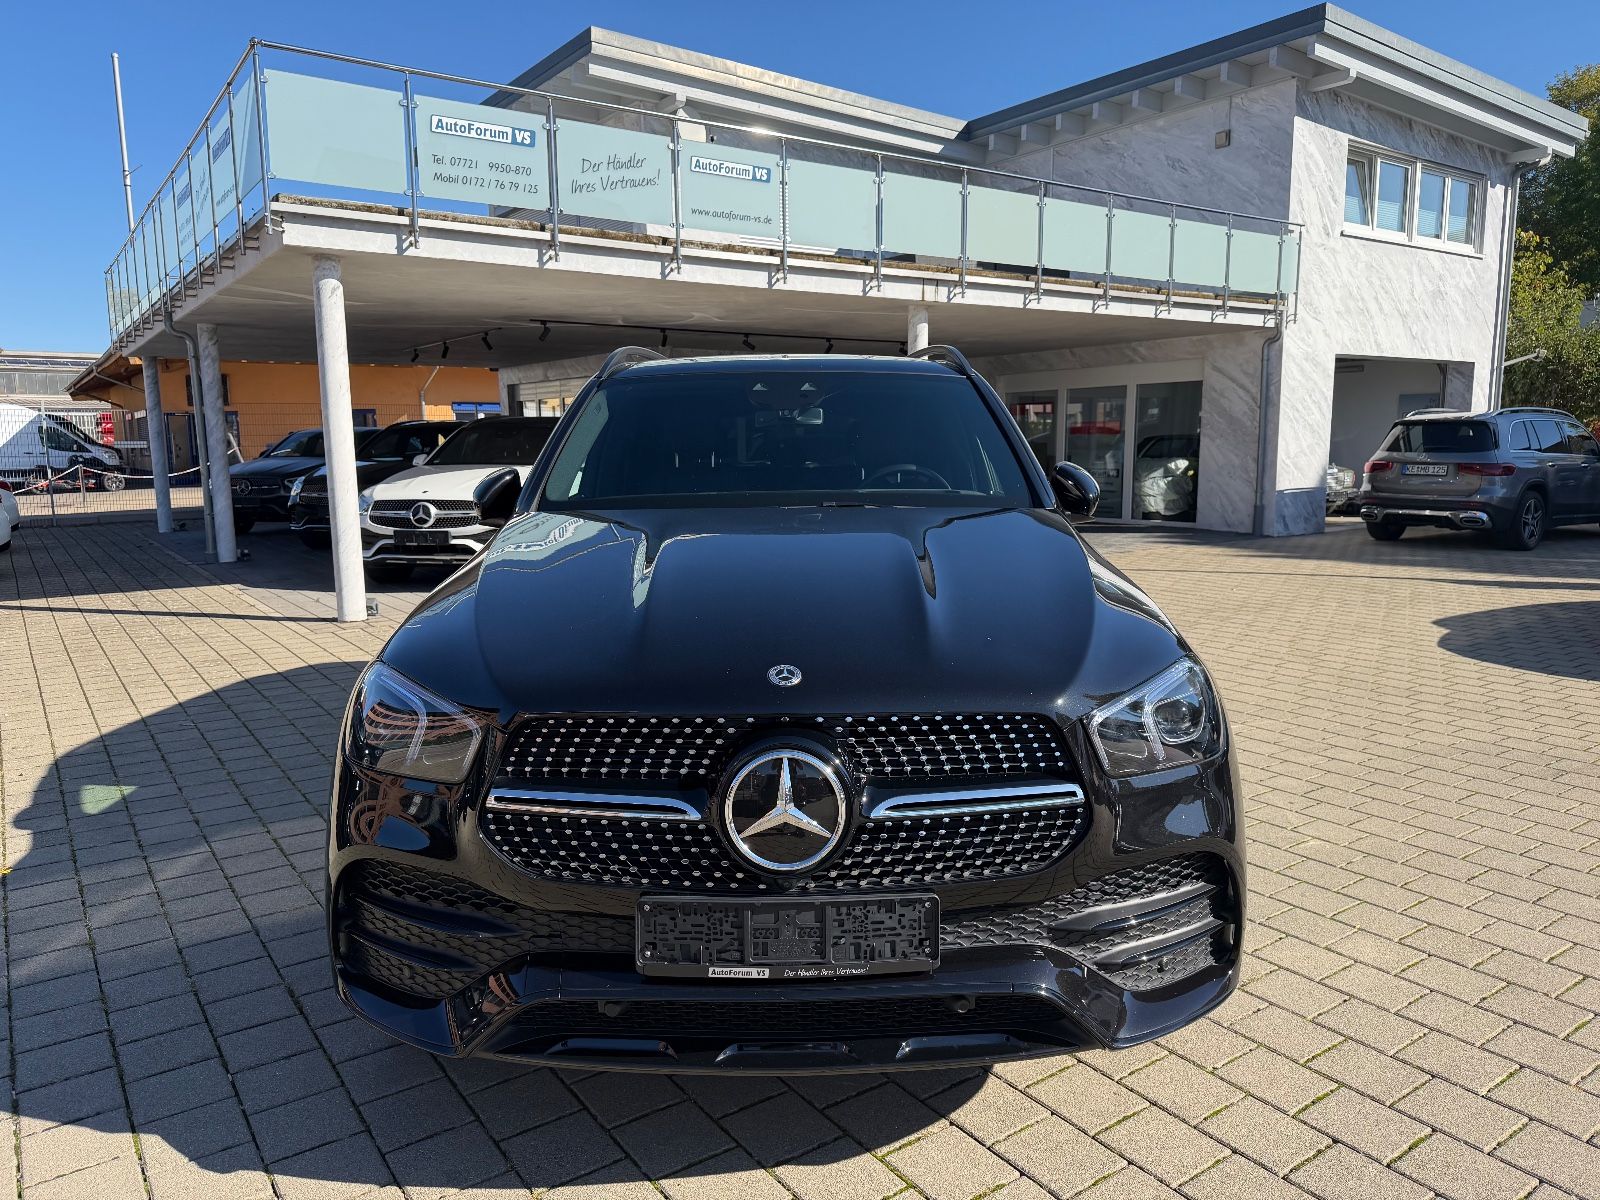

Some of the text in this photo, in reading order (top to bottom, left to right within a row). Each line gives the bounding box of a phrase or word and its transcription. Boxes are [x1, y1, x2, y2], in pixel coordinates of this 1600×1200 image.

[434, 118, 531, 144] AutoForum VS
[431, 153, 532, 176] Tel. 07721 9950-870
[581, 152, 647, 173] Der Händler
[694, 158, 768, 181] AutoForum VS
[433, 172, 460, 184] Mobil
[523, 183, 539, 194] 125
[571, 168, 661, 194] Ihres Vertrauens!
[690, 207, 774, 225] www.autoforum-vs.de
[710, 968, 753, 977] AutoForum
[756, 969, 766, 977] VS
